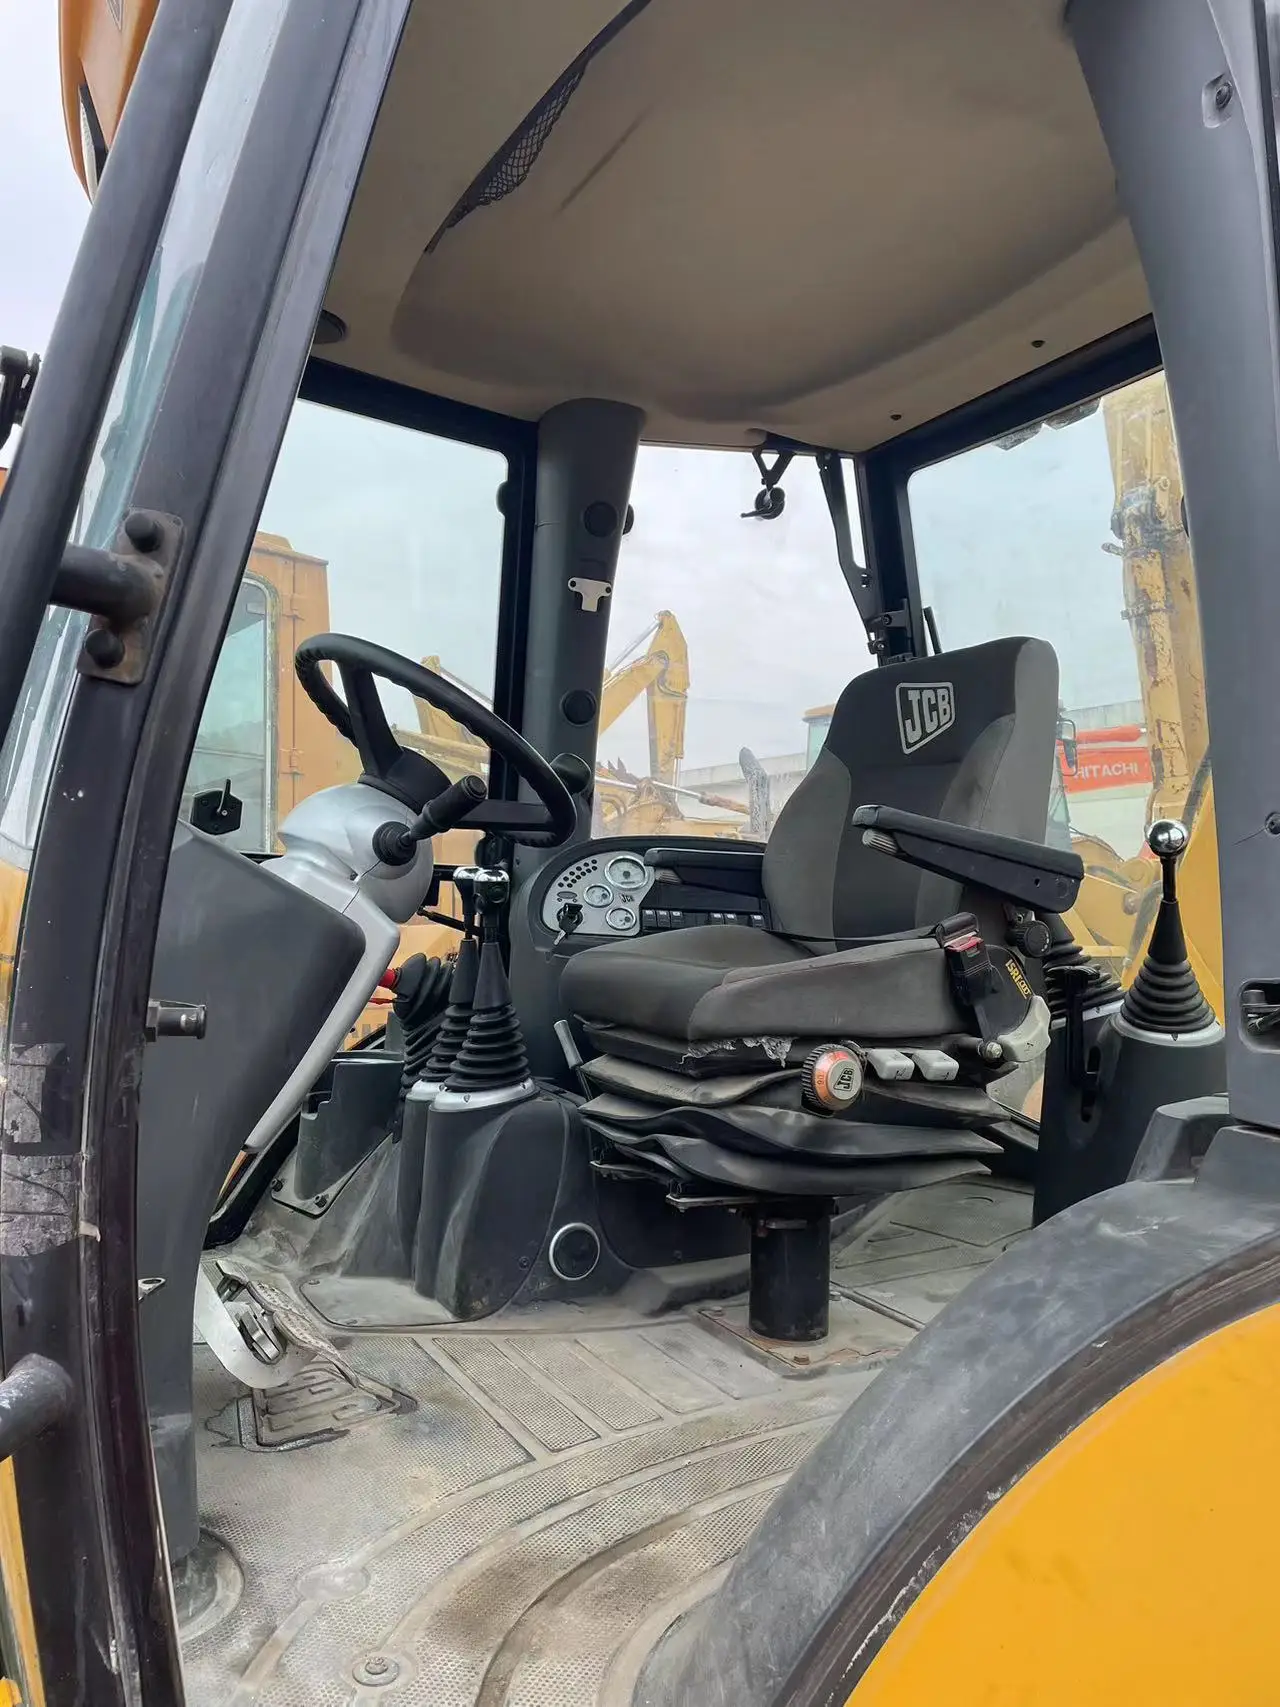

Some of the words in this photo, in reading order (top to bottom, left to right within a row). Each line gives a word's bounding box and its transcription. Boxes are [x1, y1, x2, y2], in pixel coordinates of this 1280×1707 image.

[904, 688, 951, 744] JCB
[1075, 761, 1140, 780] HITACHI
[837, 1069, 853, 1090] JCB
